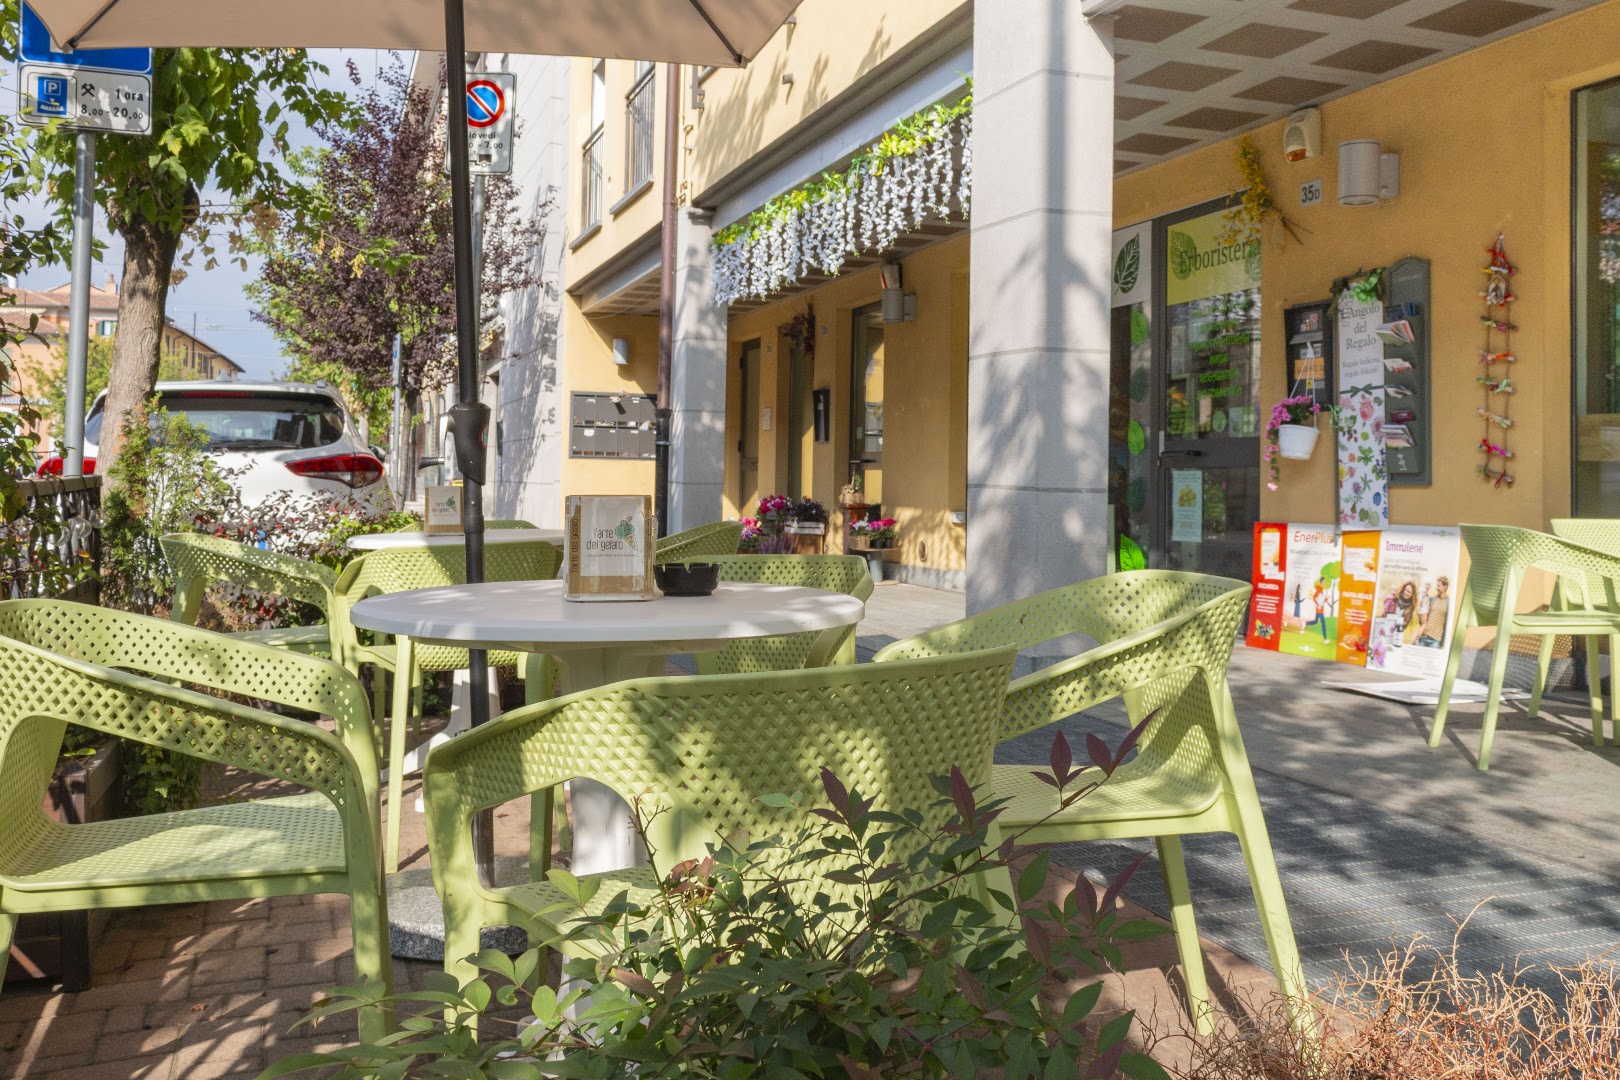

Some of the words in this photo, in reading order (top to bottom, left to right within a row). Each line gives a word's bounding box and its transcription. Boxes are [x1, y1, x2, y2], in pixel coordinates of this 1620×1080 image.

[48, 82, 57, 93] P
[125, 91, 144, 102] ora
[1301, 184, 1321, 204] 35D
[1353, 321, 1367, 334] del
[1346, 334, 1377, 351] Regalo
[594, 527, 614, 538] l'arte
[1293, 530, 1335, 544] EnerPlus
[586, 539, 599, 550] del
[600, 540, 624, 551] gelato
[1385, 541, 1425, 554] Immulene
